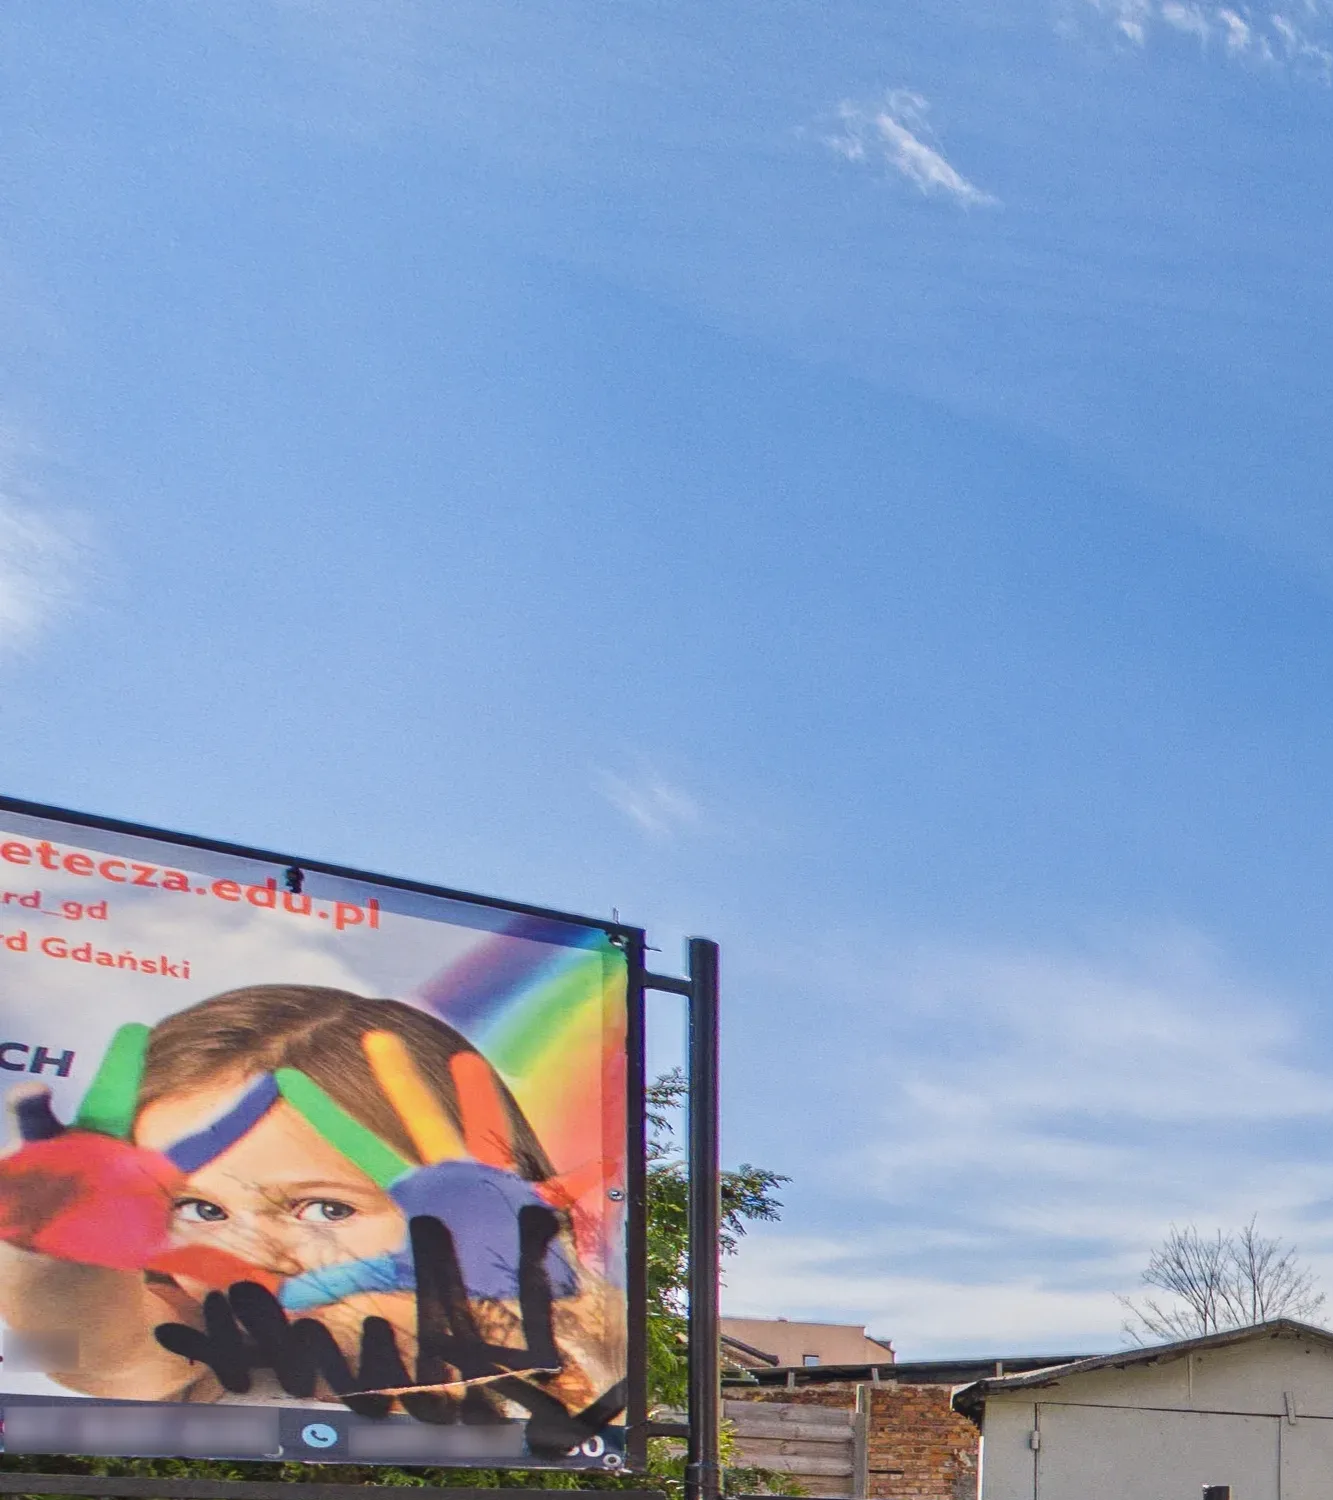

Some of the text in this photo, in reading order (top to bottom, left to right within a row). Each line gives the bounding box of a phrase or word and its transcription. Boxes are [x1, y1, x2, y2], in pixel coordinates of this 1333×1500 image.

[0, 840, 380, 930] etecza.edu.pl
[41, 937, 190, 980] Gdański
[0, 1042, 75, 1077] CH
